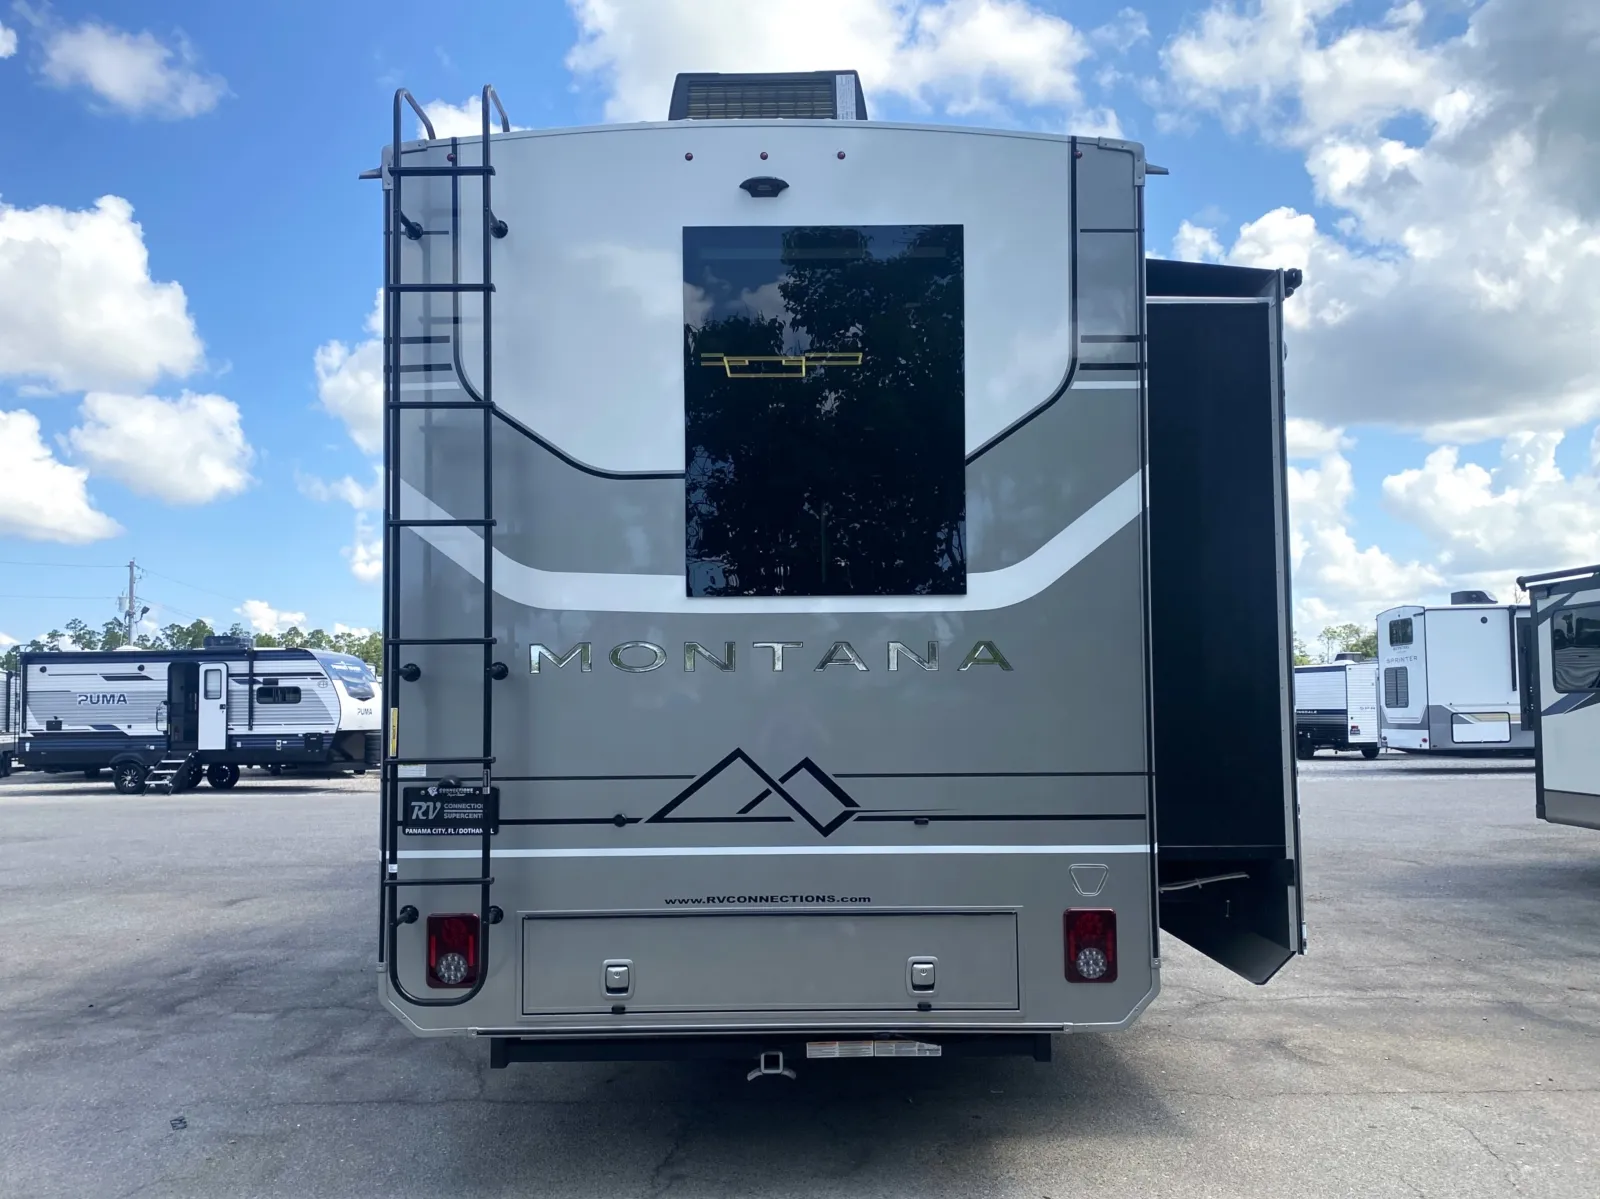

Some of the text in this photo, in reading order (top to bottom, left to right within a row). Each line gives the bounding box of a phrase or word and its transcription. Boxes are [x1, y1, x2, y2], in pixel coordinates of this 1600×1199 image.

[528, 640, 1014, 674] MONTANA
[1386, 655, 1418, 664] SPRINTER
[77, 693, 128, 705] PUMA
[357, 707, 373, 716] PUMA
[411, 801, 441, 820] RV
[664, 895, 871, 905] www.RVCONNECTIONS.com
